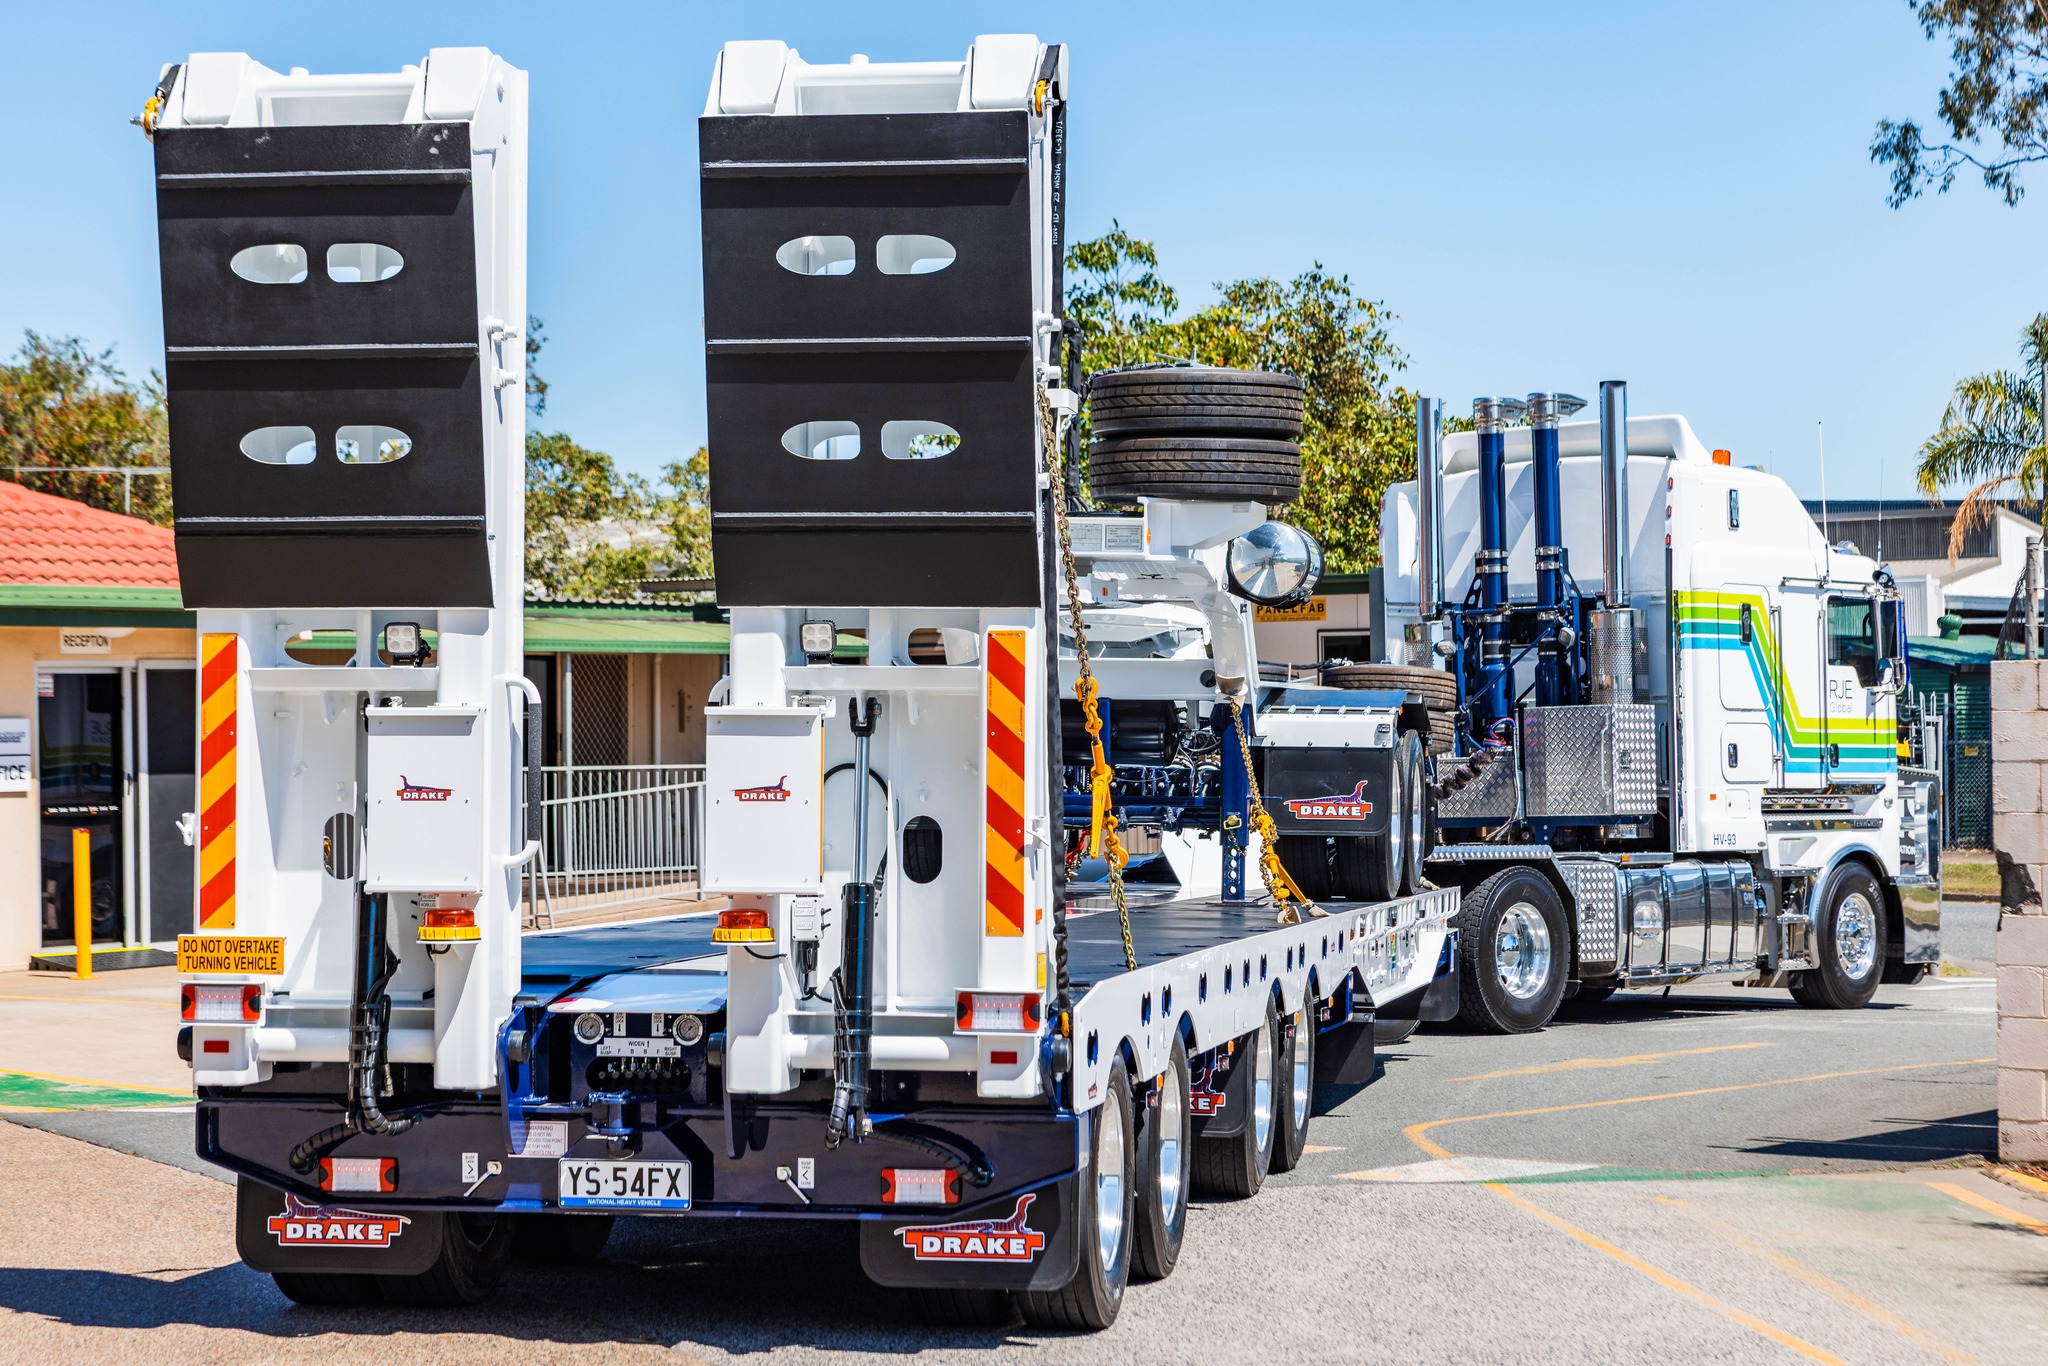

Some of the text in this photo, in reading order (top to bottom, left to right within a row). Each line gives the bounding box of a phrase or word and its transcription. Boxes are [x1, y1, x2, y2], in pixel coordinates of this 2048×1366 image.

[63, 634, 109, 647] RECEPTION
[1829, 679, 1853, 699] RJE
[1830, 701, 1854, 713] Global
[403, 792, 445, 800] DRAKE
[741, 792, 784, 800] DRAKE
[1300, 805, 1361, 816] DRAKE
[1713, 833, 1737, 845] HV-93
[183, 939, 279, 954] DO NOT OVERTAKE
[186, 956, 277, 970] TURNING VEHICLE
[285, 1222, 384, 1241] DRAKE
[922, 1236, 1027, 1256] DRAKE
